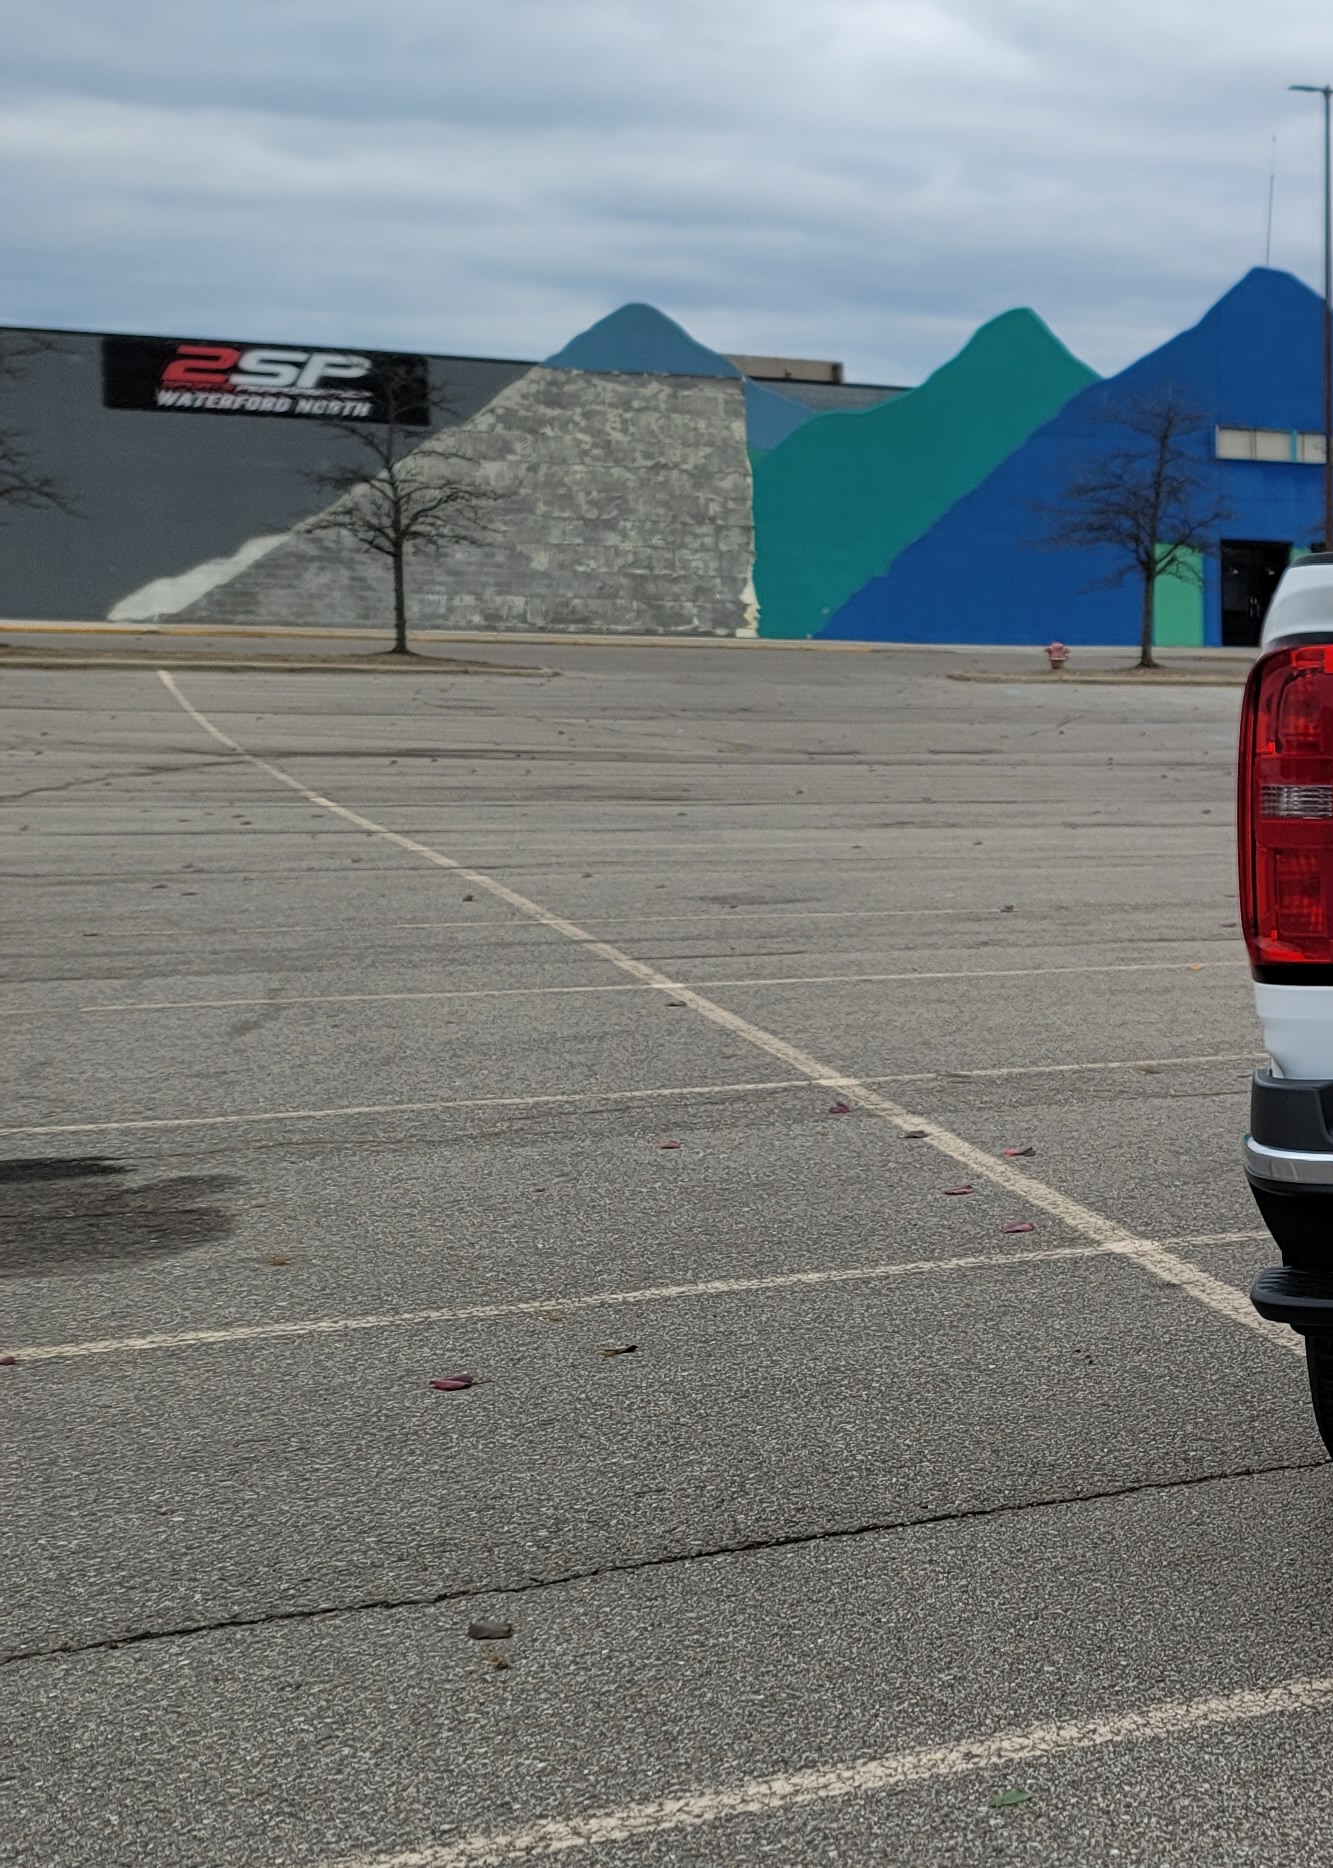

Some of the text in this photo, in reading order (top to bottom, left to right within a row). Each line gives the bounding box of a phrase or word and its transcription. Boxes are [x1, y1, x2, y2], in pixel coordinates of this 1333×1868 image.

[162, 344, 372, 388] 2SP
[156, 388, 292, 413] WATERFORD
[294, 398, 373, 417] NORTH
